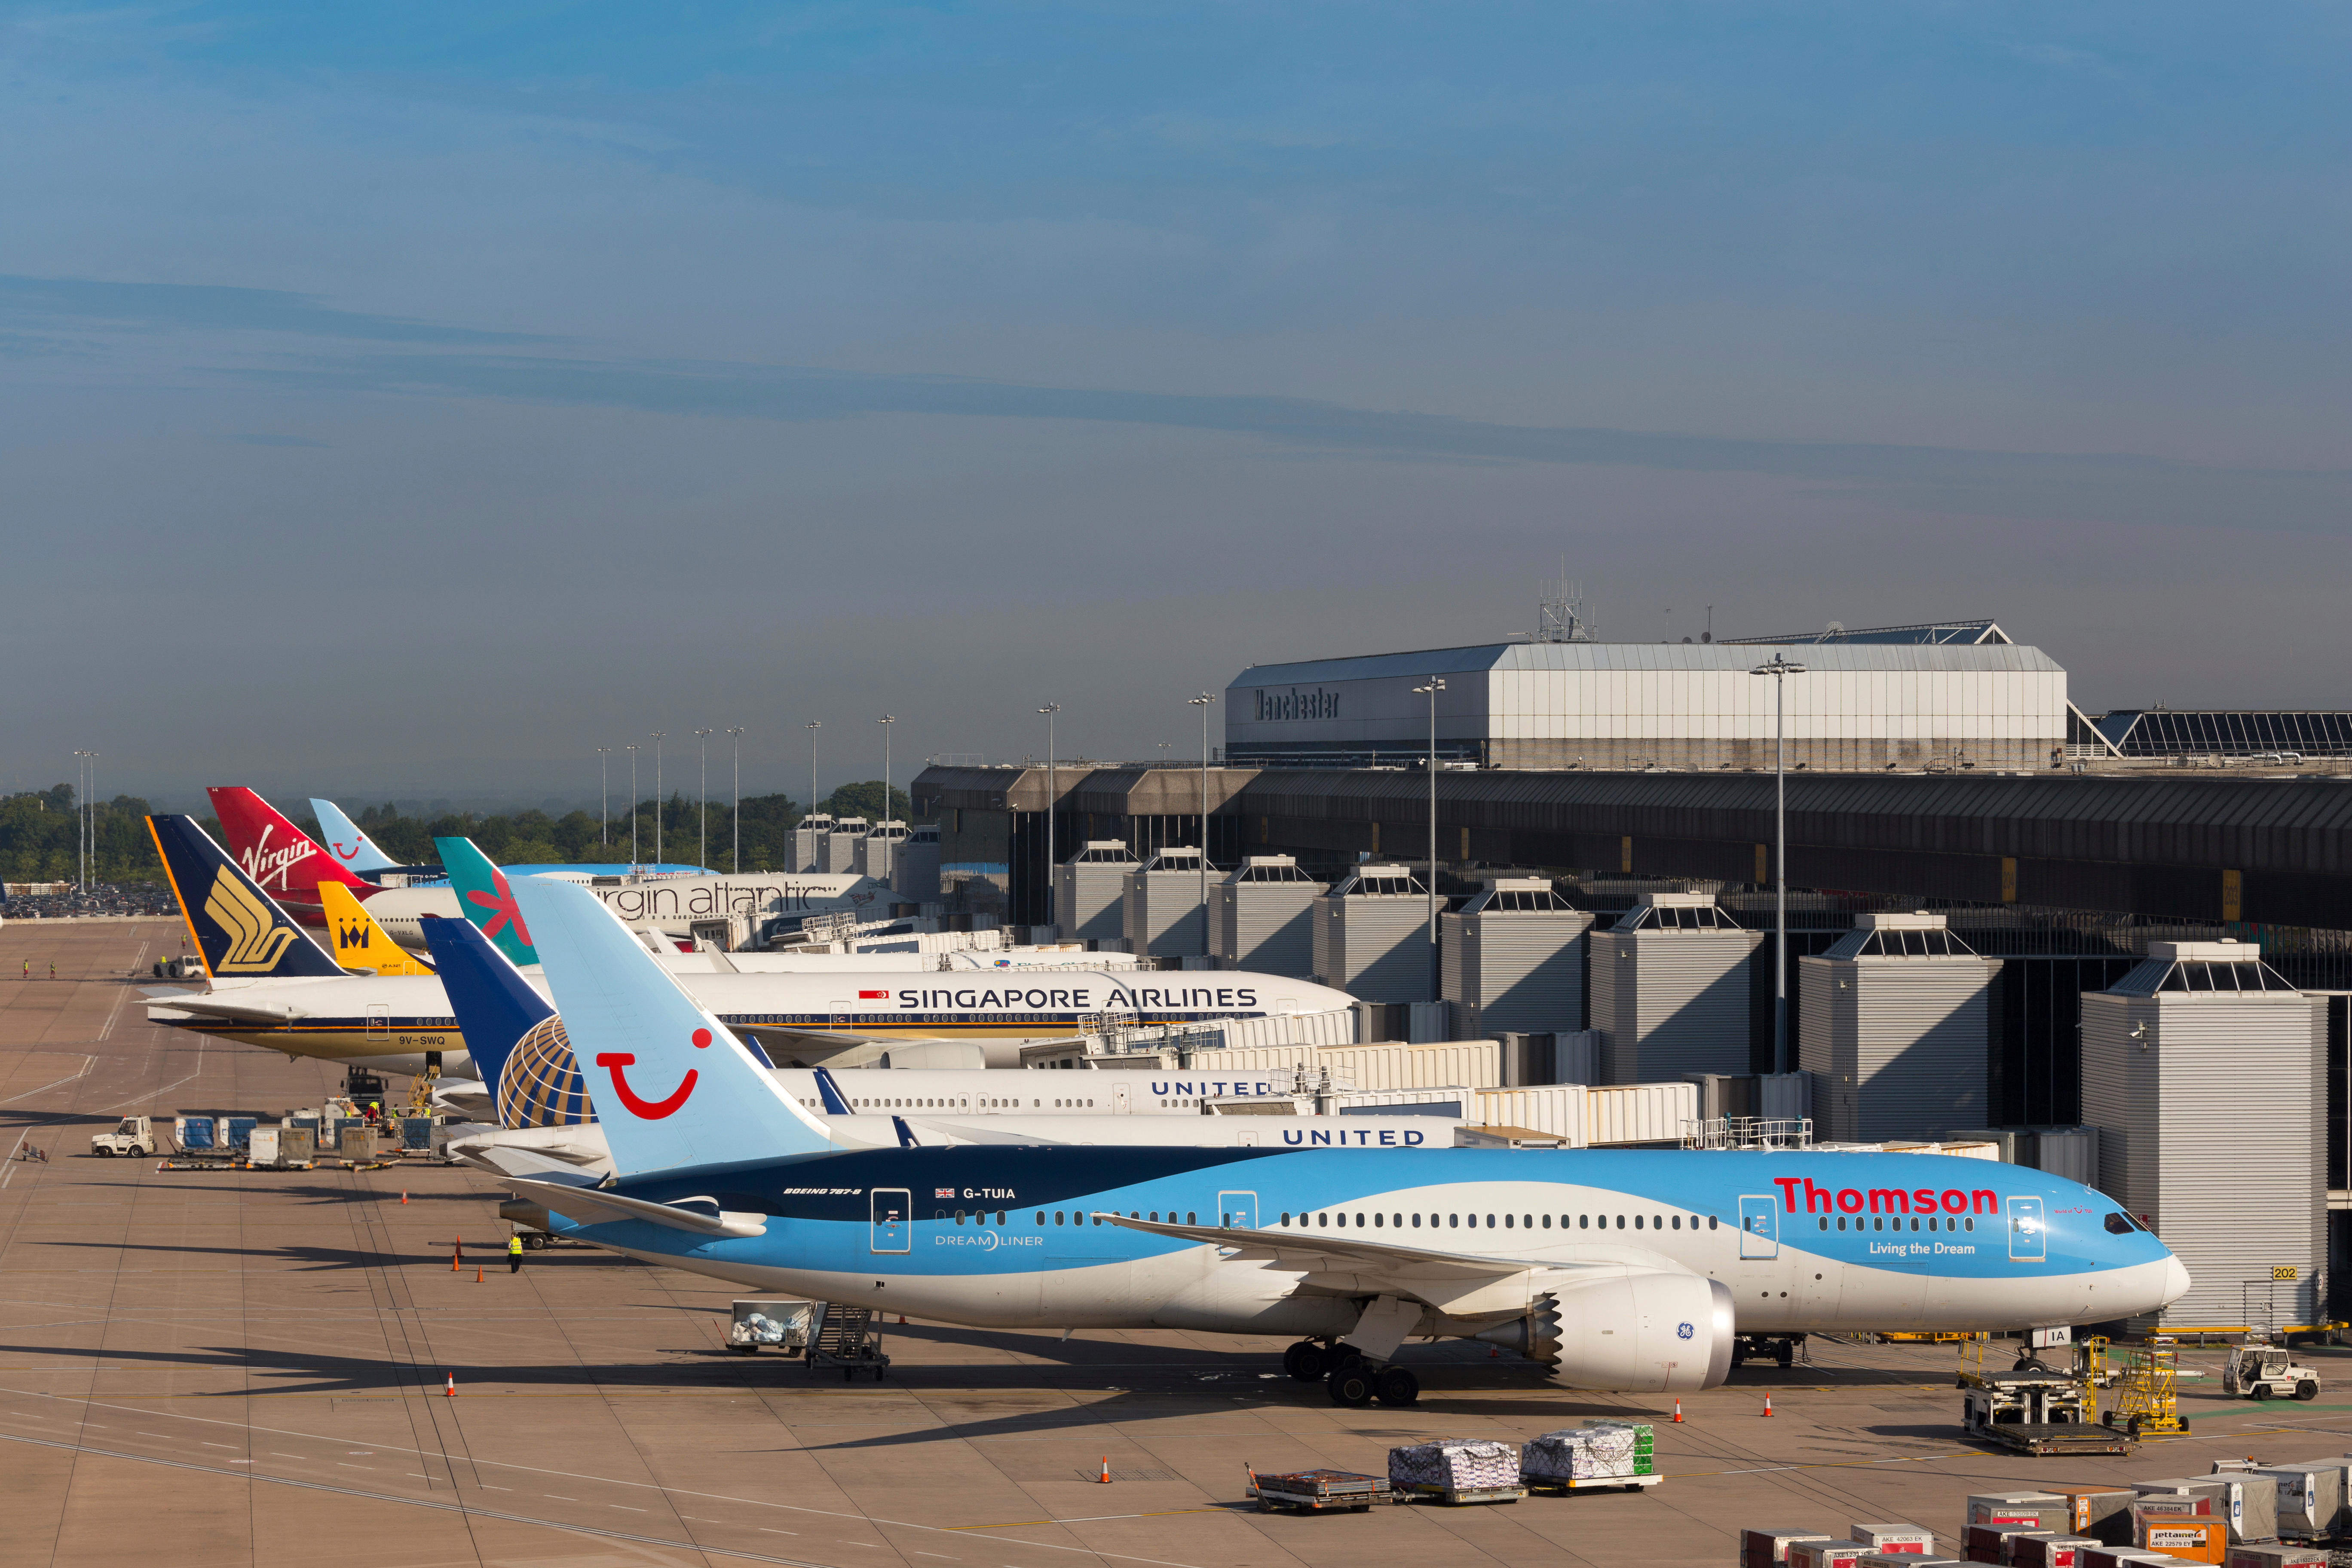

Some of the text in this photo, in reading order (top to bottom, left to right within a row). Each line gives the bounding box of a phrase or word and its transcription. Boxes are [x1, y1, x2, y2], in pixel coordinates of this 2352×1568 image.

[1255, 688, 1339, 721] Manchester
[242, 824, 317, 891] Virgin
[2004, 871, 2014, 889] 204
[689, 881, 827, 913] atlantic
[2225, 885, 2238, 905] 203
[899, 989, 1257, 1008] SINGAPORE AIRLINES
[399, 1036, 445, 1045] 9V-SWQ
[1152, 1082, 1271, 1095] UNITED
[1283, 1130, 1424, 1145] UNITED
[963, 1188, 1015, 1199] G-TUIA
[1774, 1178, 1998, 1214] Thomson
[1870, 1242, 1975, 1257] Living the Dream
[2275, 1268, 2295, 1278] 202
[2052, 1331, 2064, 1341] IA
